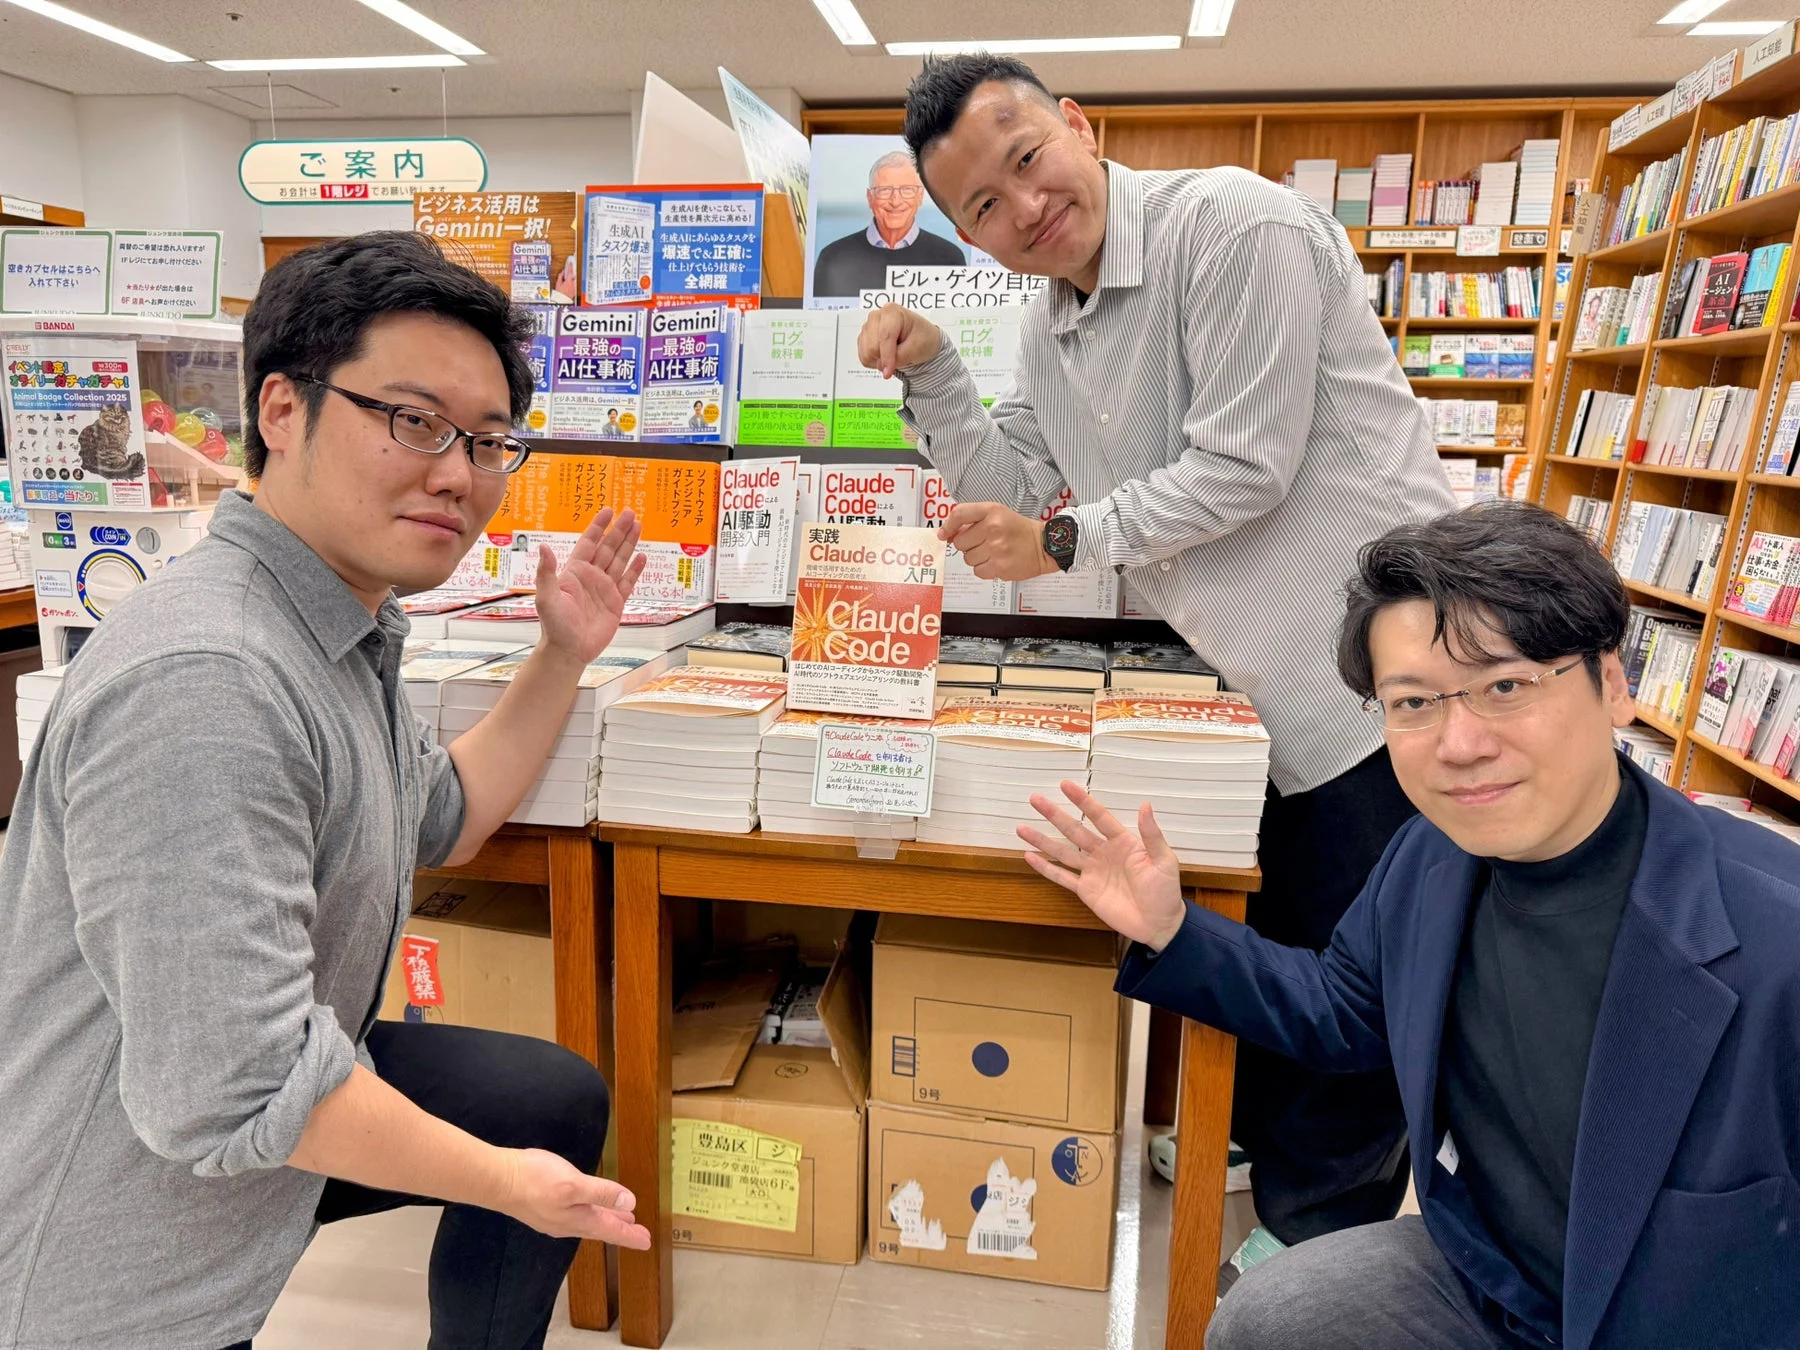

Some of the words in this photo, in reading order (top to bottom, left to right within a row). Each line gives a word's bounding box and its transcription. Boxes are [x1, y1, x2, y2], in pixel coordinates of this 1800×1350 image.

[299, 150, 425, 178] ご案内
[280, 188, 317, 198] お会計は
[323, 185, 366, 198] 1階レジ
[418, 194, 540, 215] ビジネス活用は
[671, 204, 747, 213] 生成AIを使いこなして、
[665, 213, 752, 223] 生産性を異次元に高める!
[609, 223, 645, 239] 生成AI
[660, 233, 756, 243] 生成AIにあらゆるタスクを
[601, 240, 650, 254] タスク爆速
[662, 245, 752, 260] 爆速で&正確に
[8, 264, 101, 274] 空きカプセルはこちらへ
[668, 262, 746, 273] 仕上げてもらう技術を
[28, 277, 79, 288] 入れて下さい
[684, 275, 728, 290] 全網羅
[890, 269, 1046, 290] ビル・ゲイツ自伝
[1715, 273, 1730, 286] AI
[863, 293, 945, 309] SOURCE
[43, 321, 75, 331] BANDAI
[563, 314, 633, 332] Gemini
[653, 309, 717, 333] Gemini
[573, 337, 621, 357] 最強の
[662, 336, 706, 356] 最強の
[770, 348, 804, 360] 教科書
[960, 346, 993, 358] 教科書
[558, 359, 636, 380] AI仕事術
[649, 357, 719, 381] AI仕事術
[9, 374, 130, 389] オライリーガチャガチャ!
[38, 393, 62, 402] Badge
[63, 393, 104, 401] Collection
[106, 393, 127, 402] 2025
[744, 410, 823, 420] この1冊ですべてわかる
[723, 467, 780, 490] Claude
[826, 473, 895, 494] Claude
[573, 463, 584, 522] ガイドブック
[585, 463, 595, 512] エンジニア
[683, 468, 694, 518] エンジニア
[671, 467, 682, 528] ガイドブック
[695, 468, 707, 527] ソフトウェア
[722, 489, 765, 511] Code
[824, 495, 877, 515] Code
[877, 503, 895, 511] による
[721, 510, 771, 531] AI駆動
[719, 530, 771, 548] 開発入門
[809, 528, 840, 544] 実践
[809, 544, 877, 565] Claude
[881, 548, 935, 568] Code
[904, 567, 937, 584] 入門
[827, 600, 941, 637] Claude
[824, 631, 911, 665] Code
[793, 671, 921, 687] AI時代のソフトウェアエンジニアリングの教科書
[795, 663, 930, 679] はじめてのAIコーディングからスペック駆動開発へ
[663, 685, 751, 698] Code
[674, 679, 785, 694] Claude
[1132, 702, 1258, 717] Claude
[1134, 710, 1232, 722] Code
[970, 717, 1062, 729] Code
[973, 709, 1090, 727] Claude
[919, 1087, 941, 1100] 9号
[699, 1133, 748, 1154] 豊島区
[772, 1144, 786, 1158] ジ
[692, 1156, 760, 1175] ジュンク堂書店
[672, 1228, 692, 1241] 9号
[878, 1241, 899, 1255] 9号
